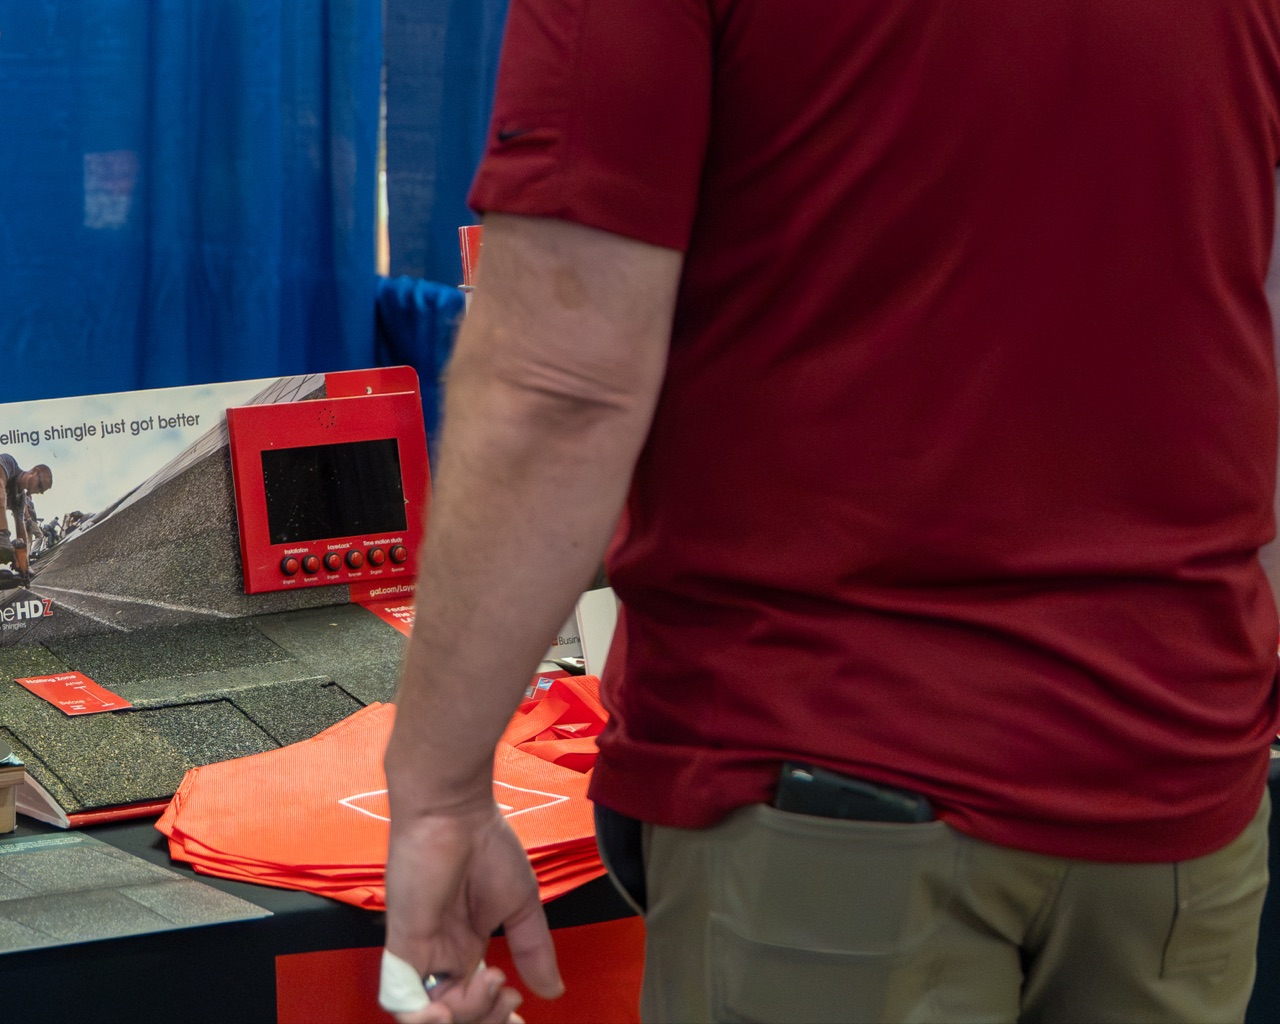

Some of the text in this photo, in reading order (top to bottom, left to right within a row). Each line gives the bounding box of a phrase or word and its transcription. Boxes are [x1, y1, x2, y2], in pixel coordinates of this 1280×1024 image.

[43, 422, 97, 442] shingle
[100, 419, 126, 439] just
[130, 416, 154, 436] got
[158, 413, 200, 430] better
[374, 538, 390, 546] motion
